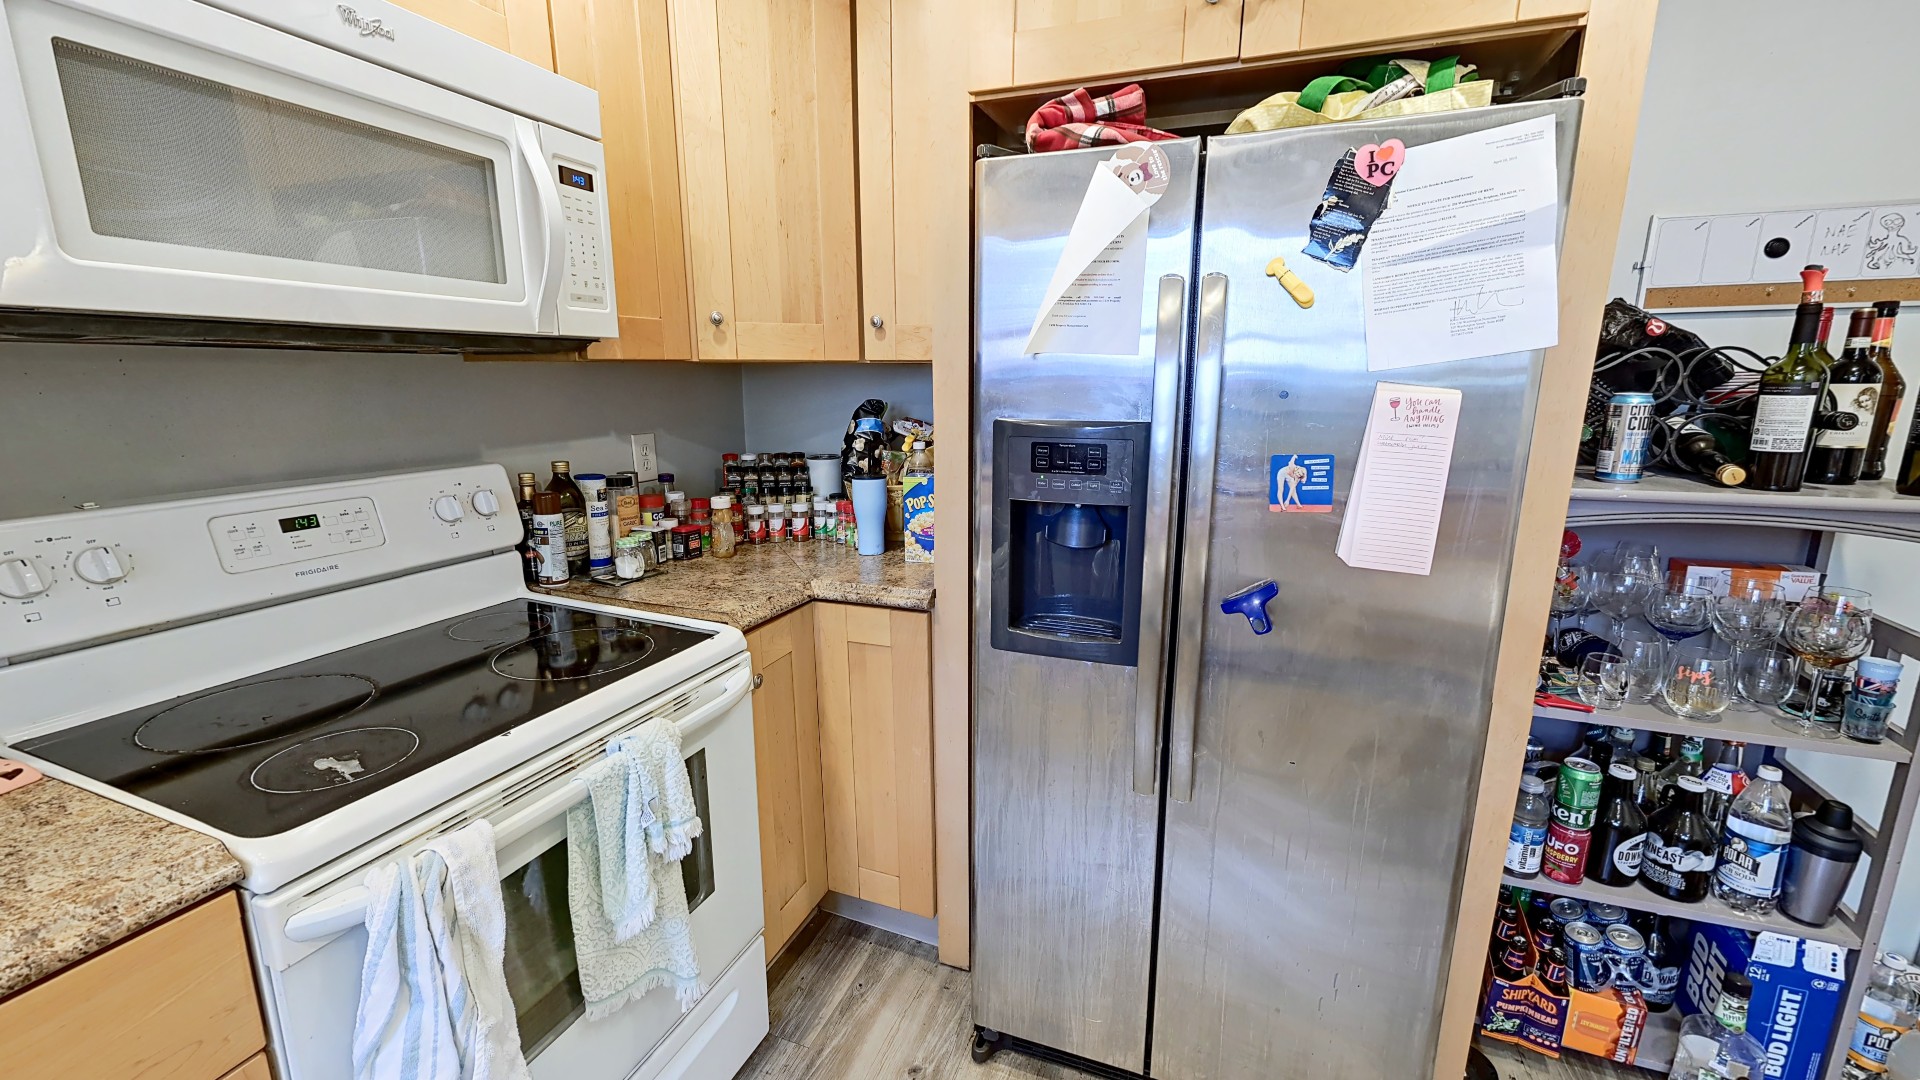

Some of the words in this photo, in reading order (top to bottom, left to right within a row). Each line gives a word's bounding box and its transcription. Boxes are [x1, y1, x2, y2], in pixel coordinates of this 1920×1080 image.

[337, 4, 395, 41] Whirlpool
[1366, 161, 1396, 179] PC
[295, 564, 340, 578] FRIGIDAIRE
[1547, 833, 1579, 855] UFO
[1723, 845, 1754, 871] POLAR
[1686, 932, 1709, 1008] BUD
[1496, 1001, 1559, 1026] PUMPKINHEAD
[1501, 988, 1557, 1015] SHIPYARD
[1772, 989, 1803, 1042] LIGHT
[1614, 1007, 1640, 1063] UNFILTERED
[1765, 1041, 1789, 1078] BUD
